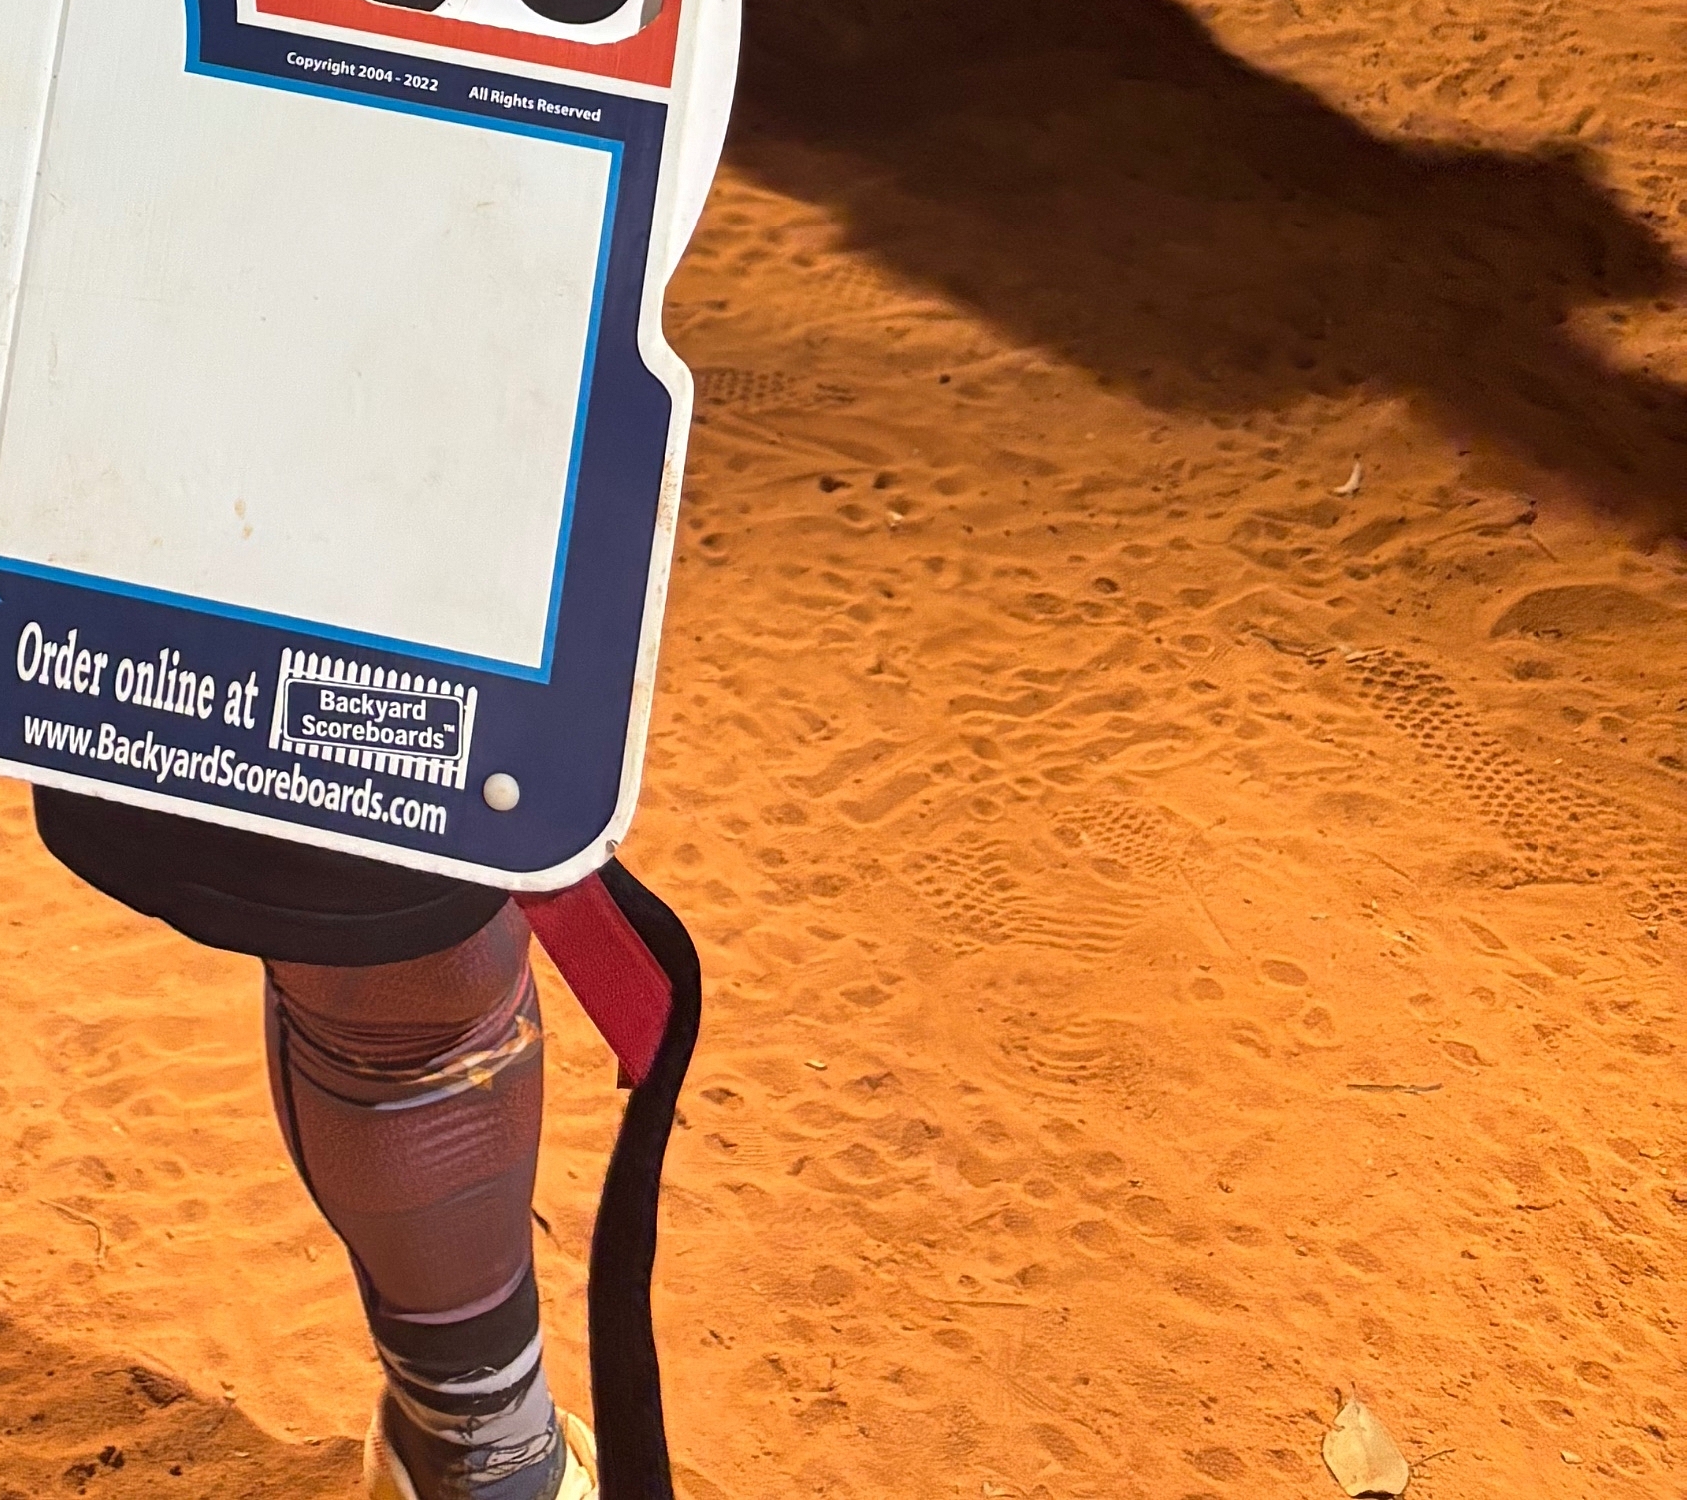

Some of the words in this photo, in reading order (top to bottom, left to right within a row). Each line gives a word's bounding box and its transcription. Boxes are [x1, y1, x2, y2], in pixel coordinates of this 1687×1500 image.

[286, 51, 356, 77] Copyright
[357, 65, 393, 83] 2004
[403, 73, 439, 92] 2022
[468, 86, 489, 101] All
[490, 89, 534, 111] Rights
[536, 98, 602, 122] Reserved
[16, 621, 109, 696] Order
[115, 647, 215, 720] online
[223, 671, 259, 730] at
[319, 689, 427, 724] Backyard
[24, 715, 447, 835] www.BackyardScoreboards.com
